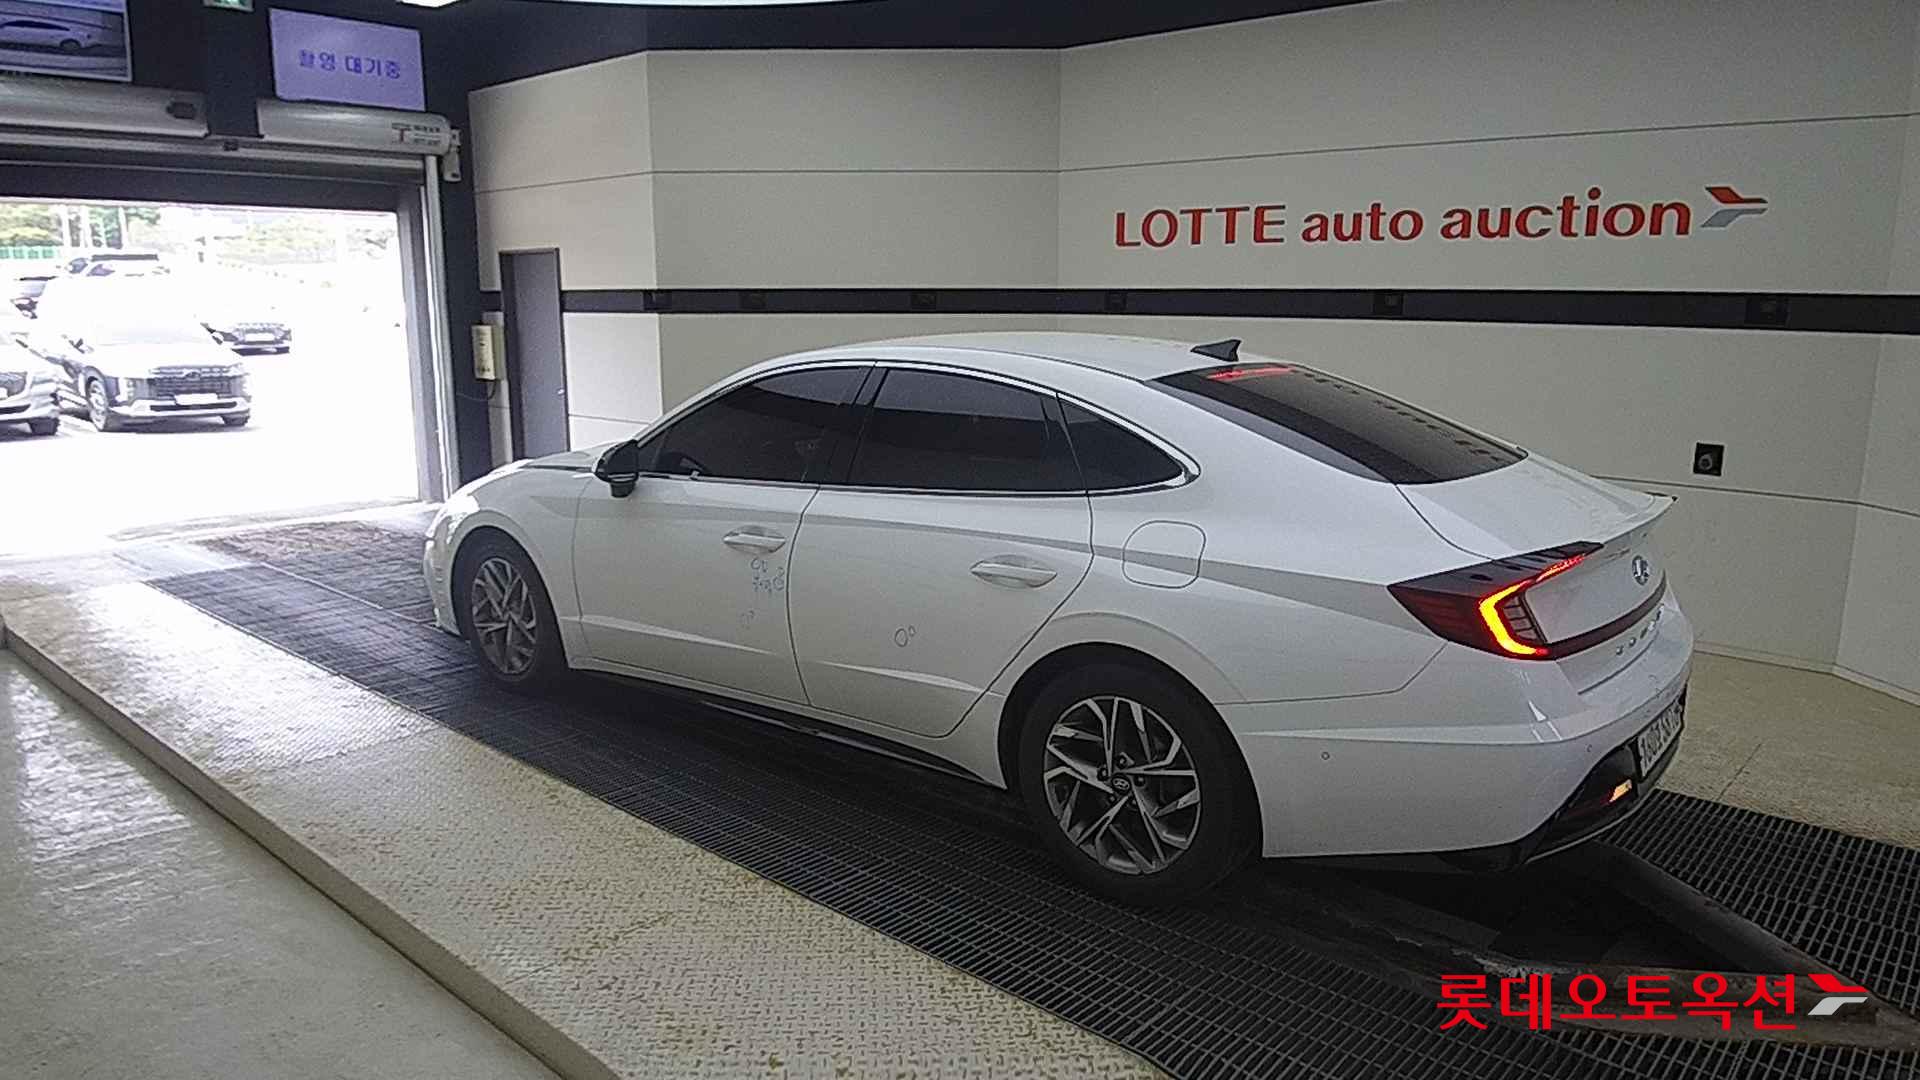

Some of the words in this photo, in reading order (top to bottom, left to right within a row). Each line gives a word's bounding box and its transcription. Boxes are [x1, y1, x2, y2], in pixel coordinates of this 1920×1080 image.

[1115, 205, 1286, 247] LOTTE
[1301, 203, 1424, 242] auto
[1439, 187, 1693, 239] auction
